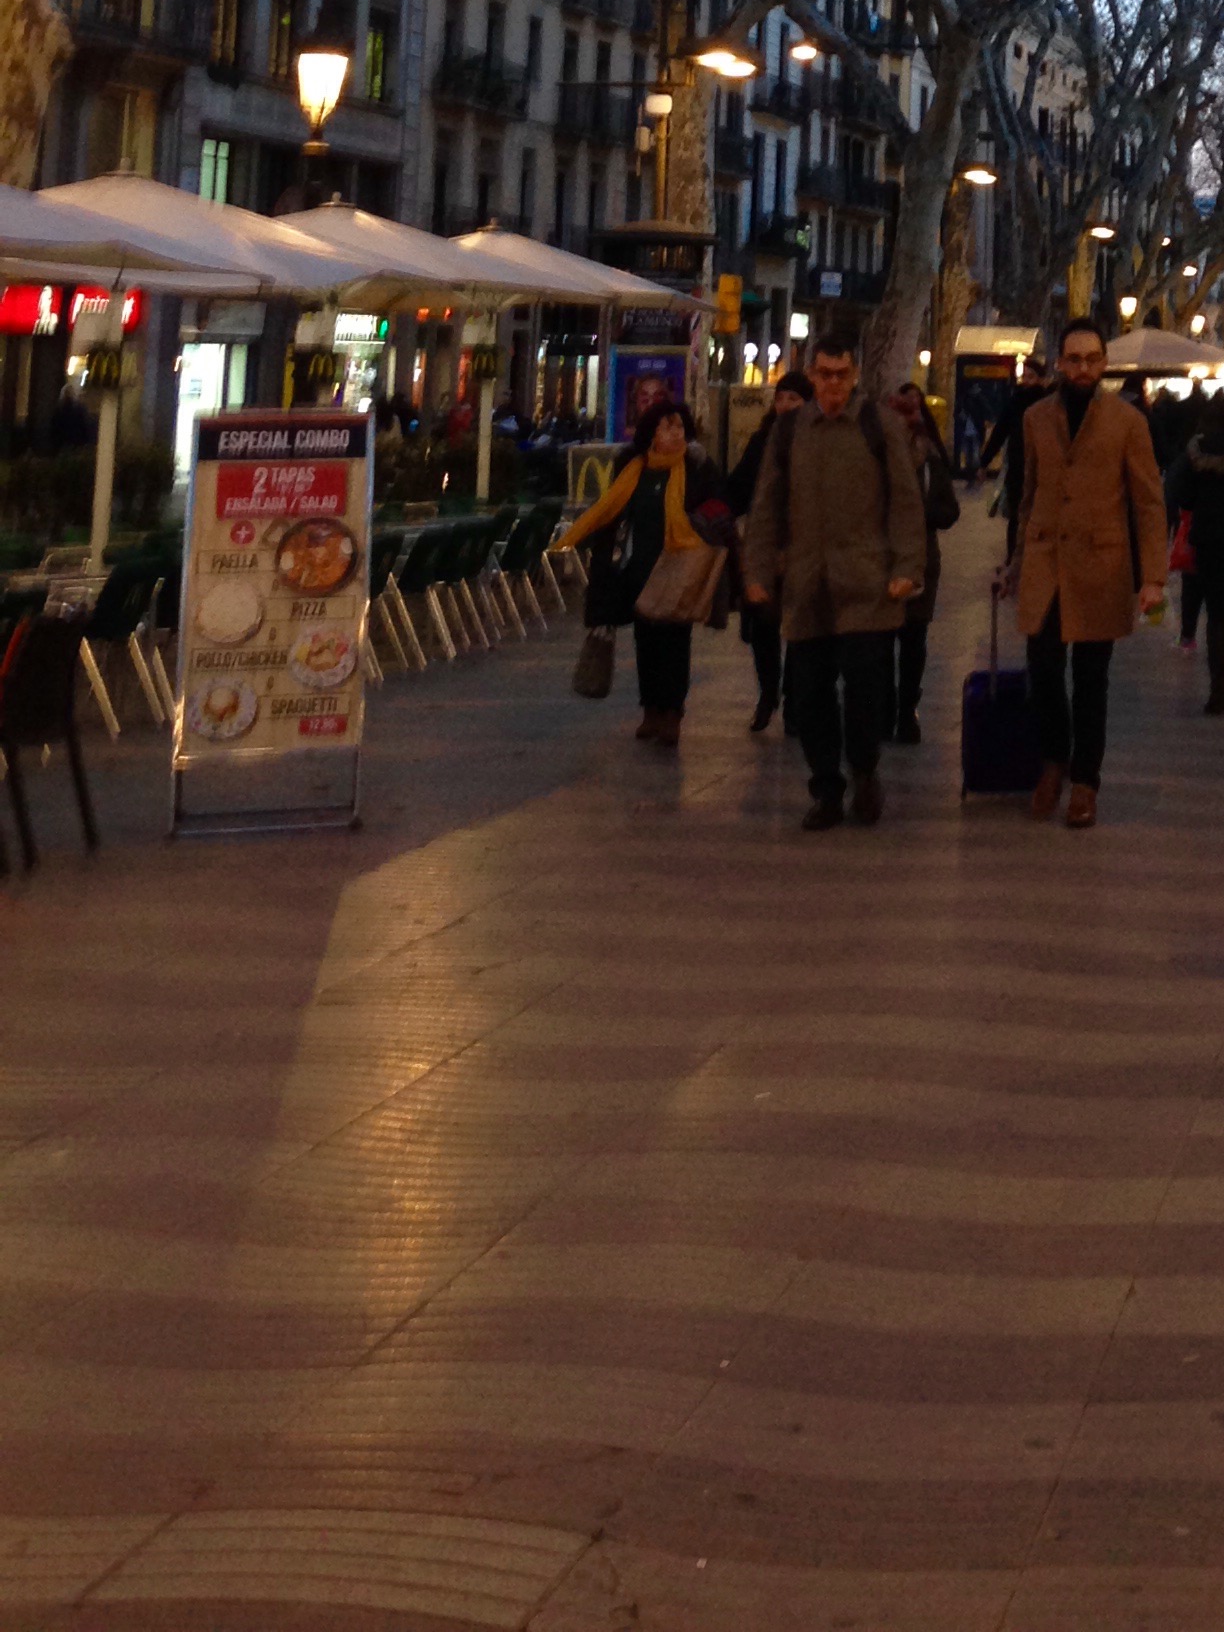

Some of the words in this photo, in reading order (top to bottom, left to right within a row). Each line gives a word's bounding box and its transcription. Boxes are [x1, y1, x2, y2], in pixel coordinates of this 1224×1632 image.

[218, 430, 292, 452] ESPECIAL
[294, 429, 350, 450] COMBO
[252, 467, 269, 494] 2
[271, 467, 316, 486] TAPAS
[225, 496, 287, 512] ENSALADA
[300, 495, 338, 510] SALAD
[211, 553, 259, 572] PAELLA
[291, 600, 327, 618] PIZZA
